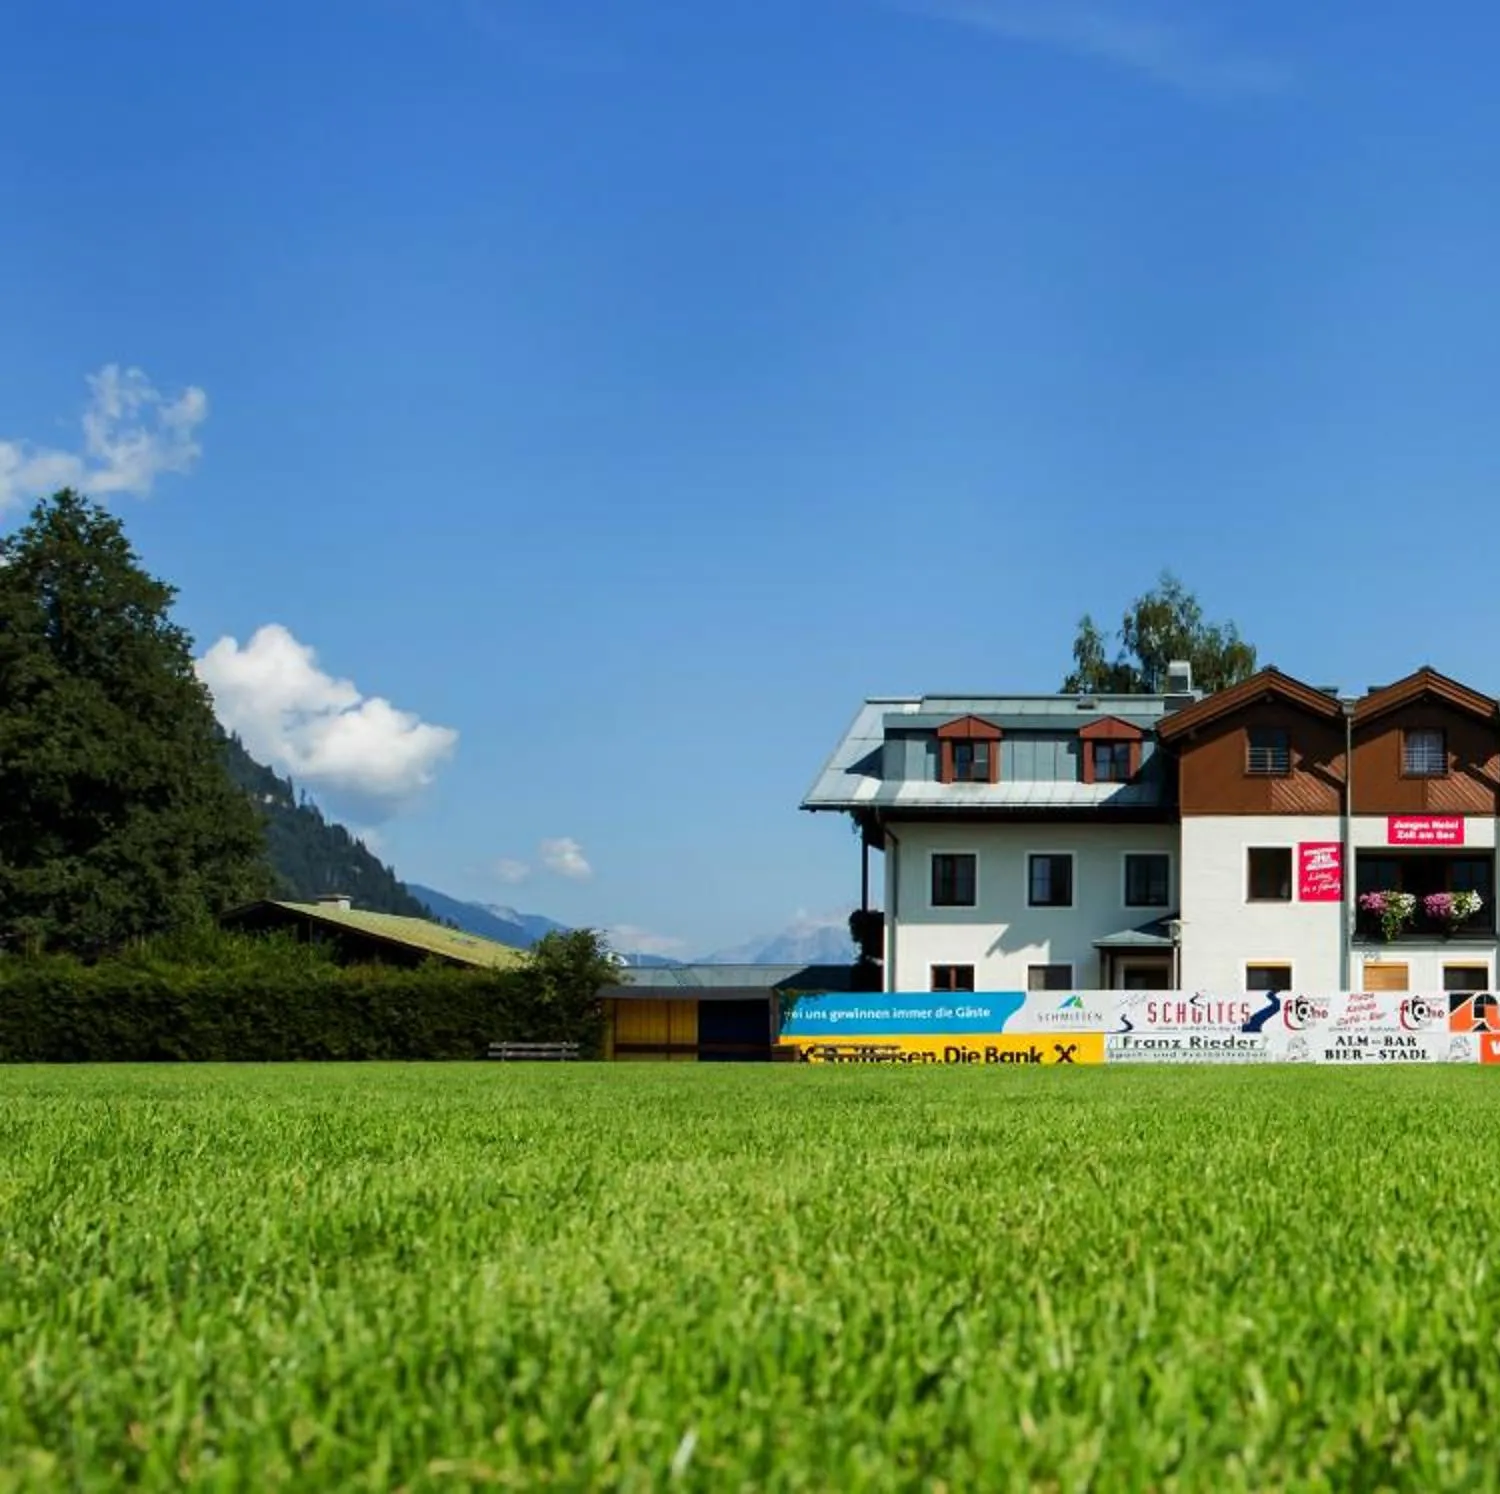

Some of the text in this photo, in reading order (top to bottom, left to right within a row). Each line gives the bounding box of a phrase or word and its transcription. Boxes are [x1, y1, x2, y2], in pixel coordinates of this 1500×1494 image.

[806, 1010, 826, 1019] uns
[830, 1008, 890, 1022] gewinnen
[893, 1008, 932, 1019] immer
[935, 1007, 952, 1019] die
[955, 1007, 991, 1018] Gäste
[1123, 1035, 1258, 1049] Franz Rieder
[1336, 1036, 1369, 1046] ALM
[1384, 1036, 1417, 1046] BAR
[985, 1046, 1043, 1062] Bank
[1325, 1049, 1362, 1060] BIER
